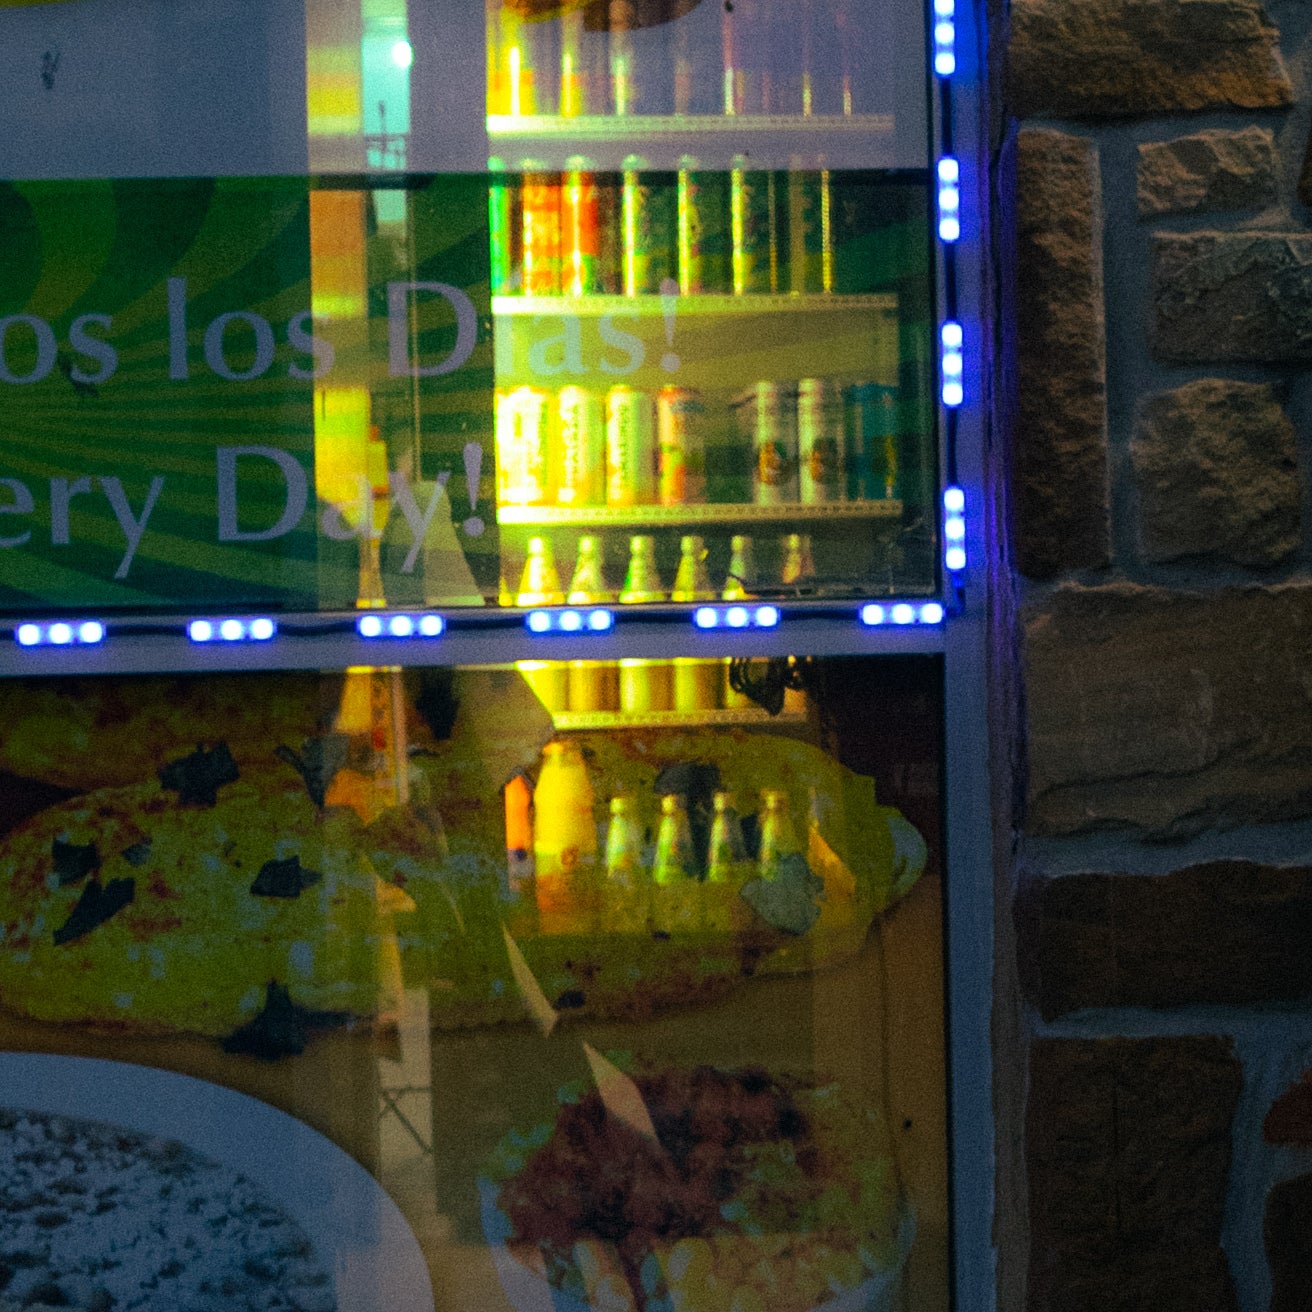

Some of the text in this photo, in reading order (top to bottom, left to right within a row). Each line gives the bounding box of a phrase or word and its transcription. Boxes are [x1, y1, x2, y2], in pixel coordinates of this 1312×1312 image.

[0, 311, 119, 386] os
[166, 276, 337, 385] los
[0, 474, 166, 579] ery
[215, 442, 486, 575] Day!
